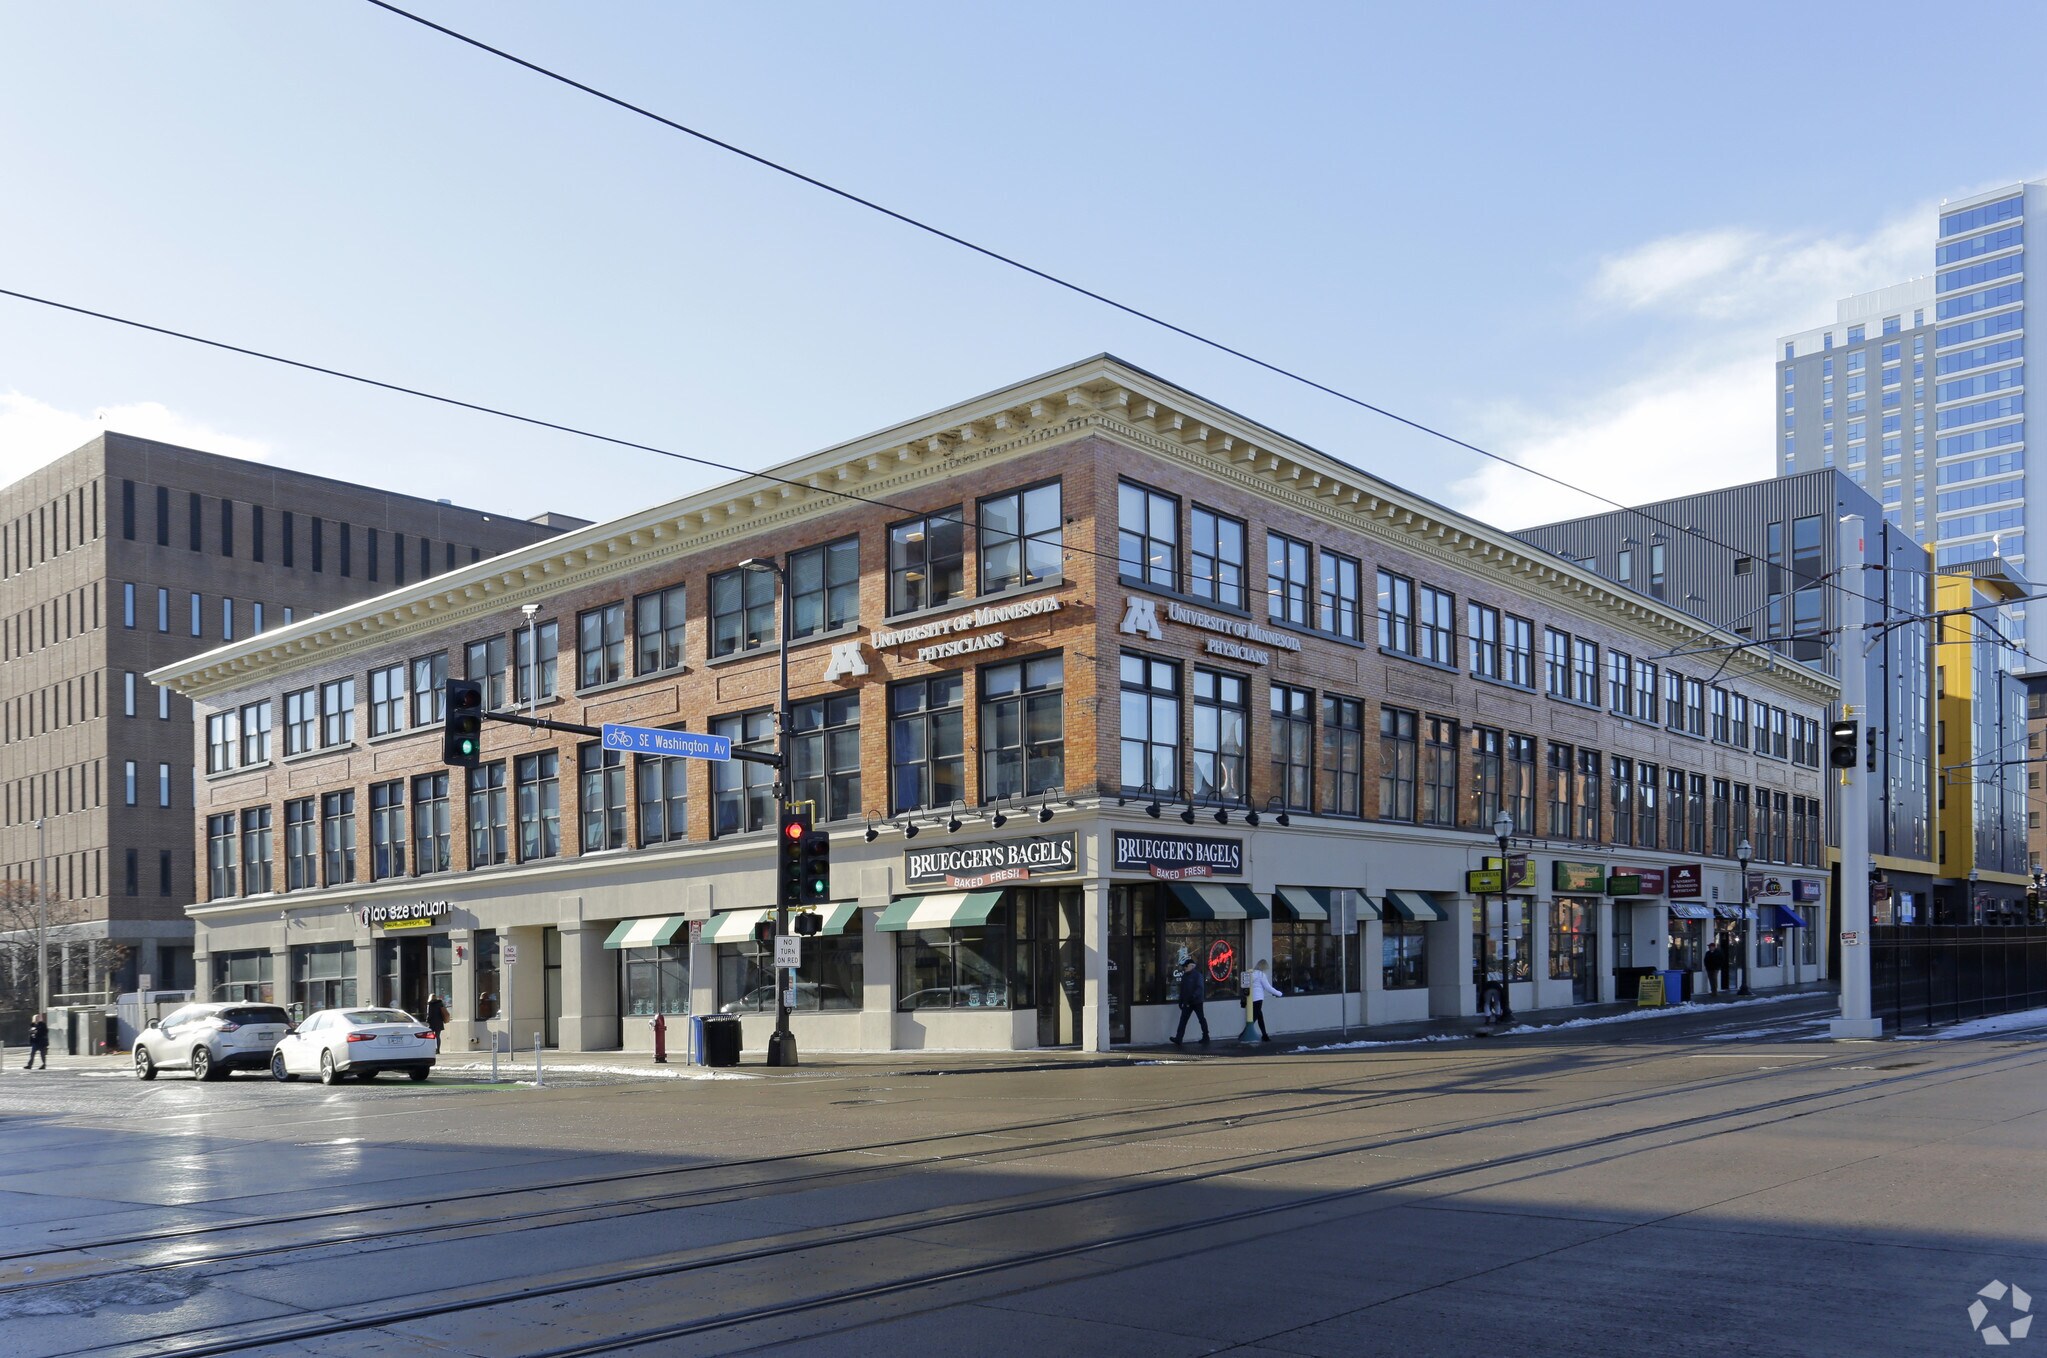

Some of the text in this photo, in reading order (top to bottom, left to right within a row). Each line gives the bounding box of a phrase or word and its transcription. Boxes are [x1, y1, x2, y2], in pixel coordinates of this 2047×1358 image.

[870, 596, 1062, 650] UNIVERSITY OF MINNESOTA
[1167, 601, 1302, 652] UNIVERSITY OF MINNESOTA
[917, 631, 1006, 662] PHYSICIANS
[1207, 639, 1269, 666] PHYSICIANS
[639, 733, 726, 755] SE Washington Av
[909, 839, 1072, 879] BRUEGGER'S BAGELS
[1117, 837, 1239, 869] BRUEGGER'S BAGELS
[954, 868, 1020, 888] BAKED FRESH
[1156, 866, 1206, 880] BAKED FRESH
[371, 900, 446, 921] lao sze chuan
